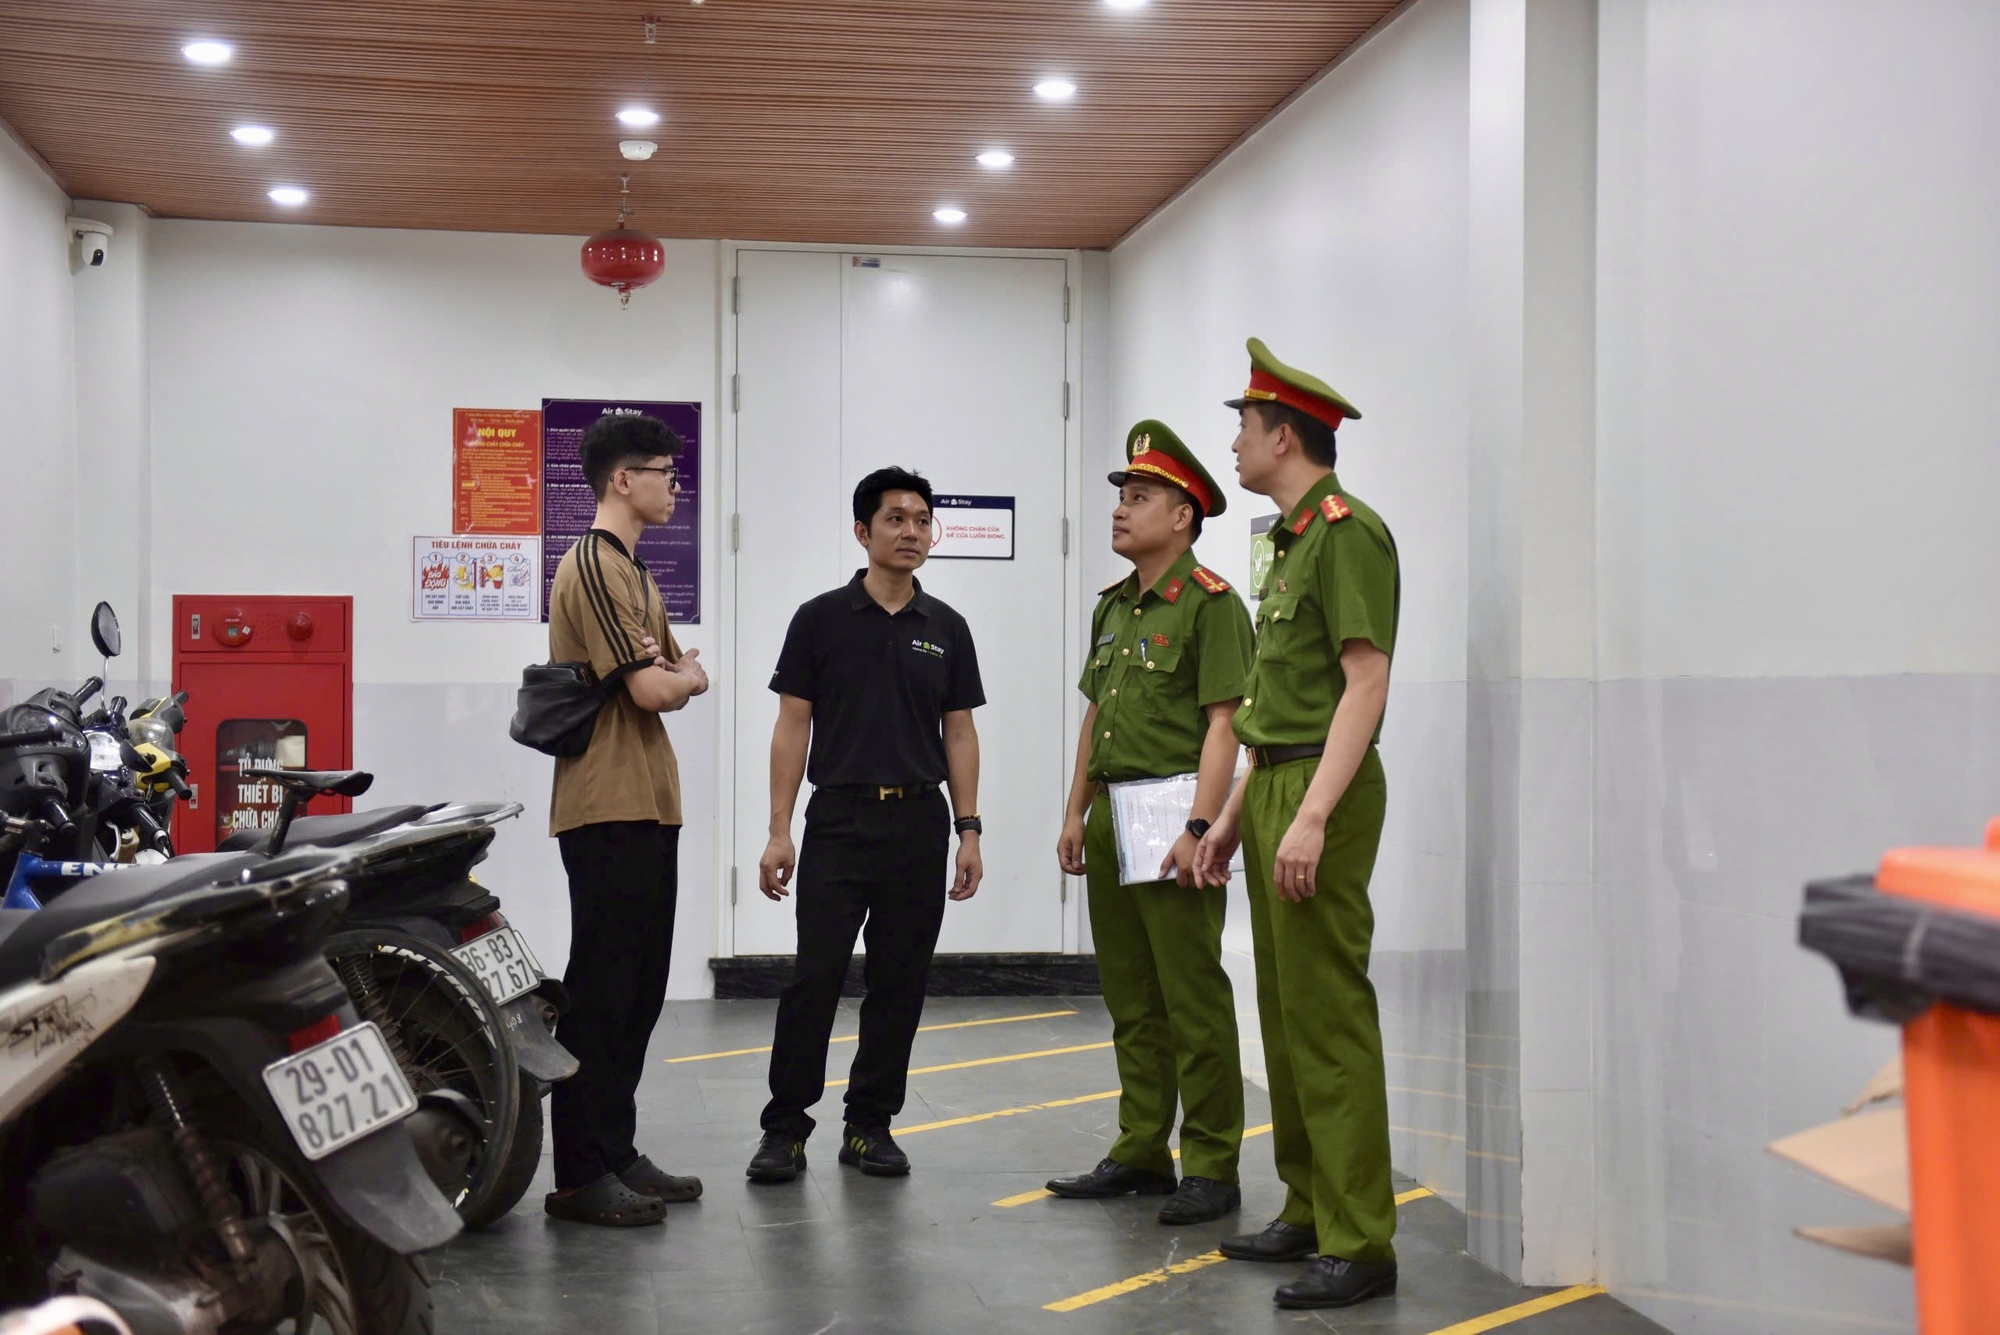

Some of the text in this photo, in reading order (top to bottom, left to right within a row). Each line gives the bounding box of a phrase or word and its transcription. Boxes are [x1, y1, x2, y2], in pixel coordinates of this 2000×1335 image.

[602, 407, 642, 416] Air Stay
[497, 428, 517, 438] QUY
[431, 540, 521, 550] TIÊU LỆNH CHỮA CHÁY
[912, 639, 922, 647] Air
[930, 643, 945, 655] Stay
[238, 777, 269, 804] THIẾT
[233, 806, 258, 829] CHỮA
[460, 934, 514, 976] 36-B3
[285, 1038, 374, 1105] 29-D1
[298, 1073, 404, 1149] 827.21
